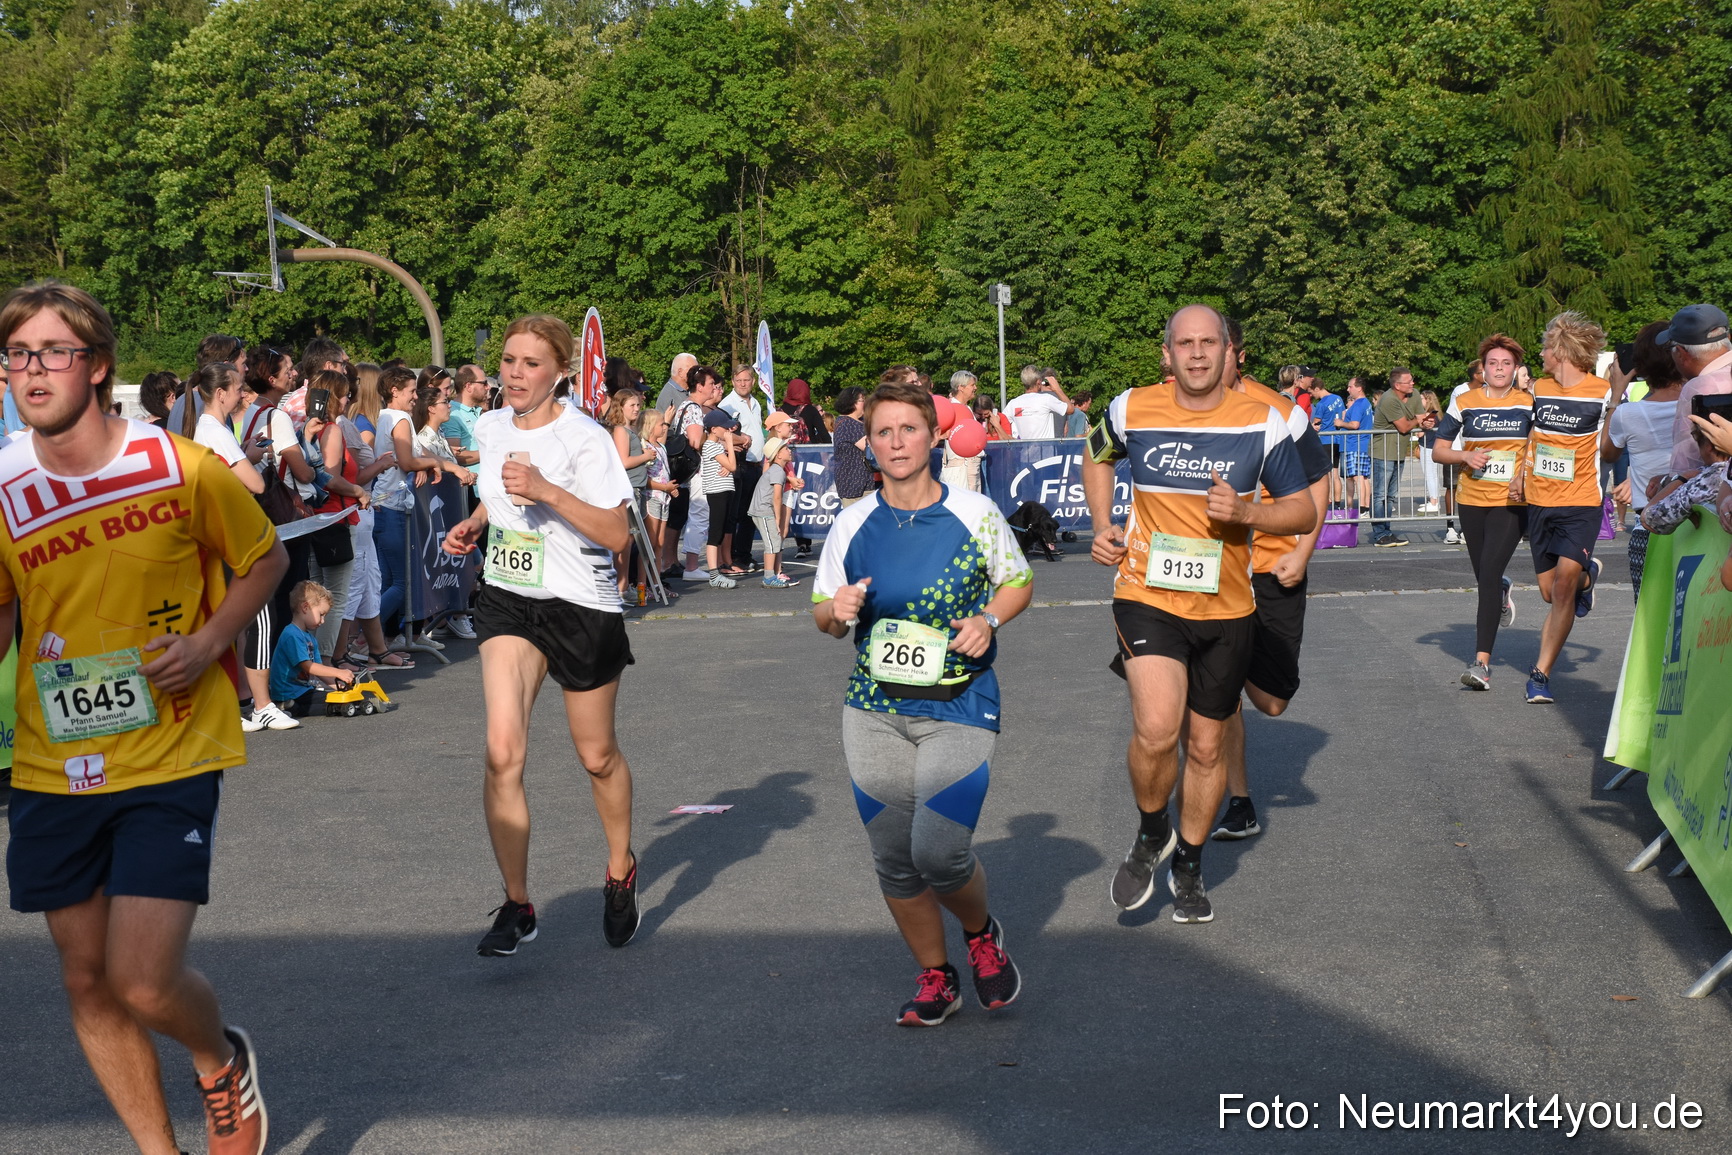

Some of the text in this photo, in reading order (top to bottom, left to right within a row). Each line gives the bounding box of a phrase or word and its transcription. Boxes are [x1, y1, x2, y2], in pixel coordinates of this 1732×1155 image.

[1481, 418, 1522, 428] Fischer
[1542, 411, 1582, 424] Fischer
[1544, 421, 1578, 429] AUTOMOBILE
[1158, 454, 1236, 472] Fischer
[1542, 459, 1565, 473] 9135
[18, 499, 191, 573] MAX BÖGL
[492, 545, 533, 571] 2168
[1163, 558, 1204, 579] 9133
[882, 642, 926, 668] 266
[878, 664, 928, 676] Schmidtner Heike
[53, 679, 135, 718] 1645
[70, 710, 127, 726] Pfann Samuel
[74, 725, 88, 733] Bögl
[88, 721, 119, 730] Bauservice
[120, 716, 138, 724] GmbH
